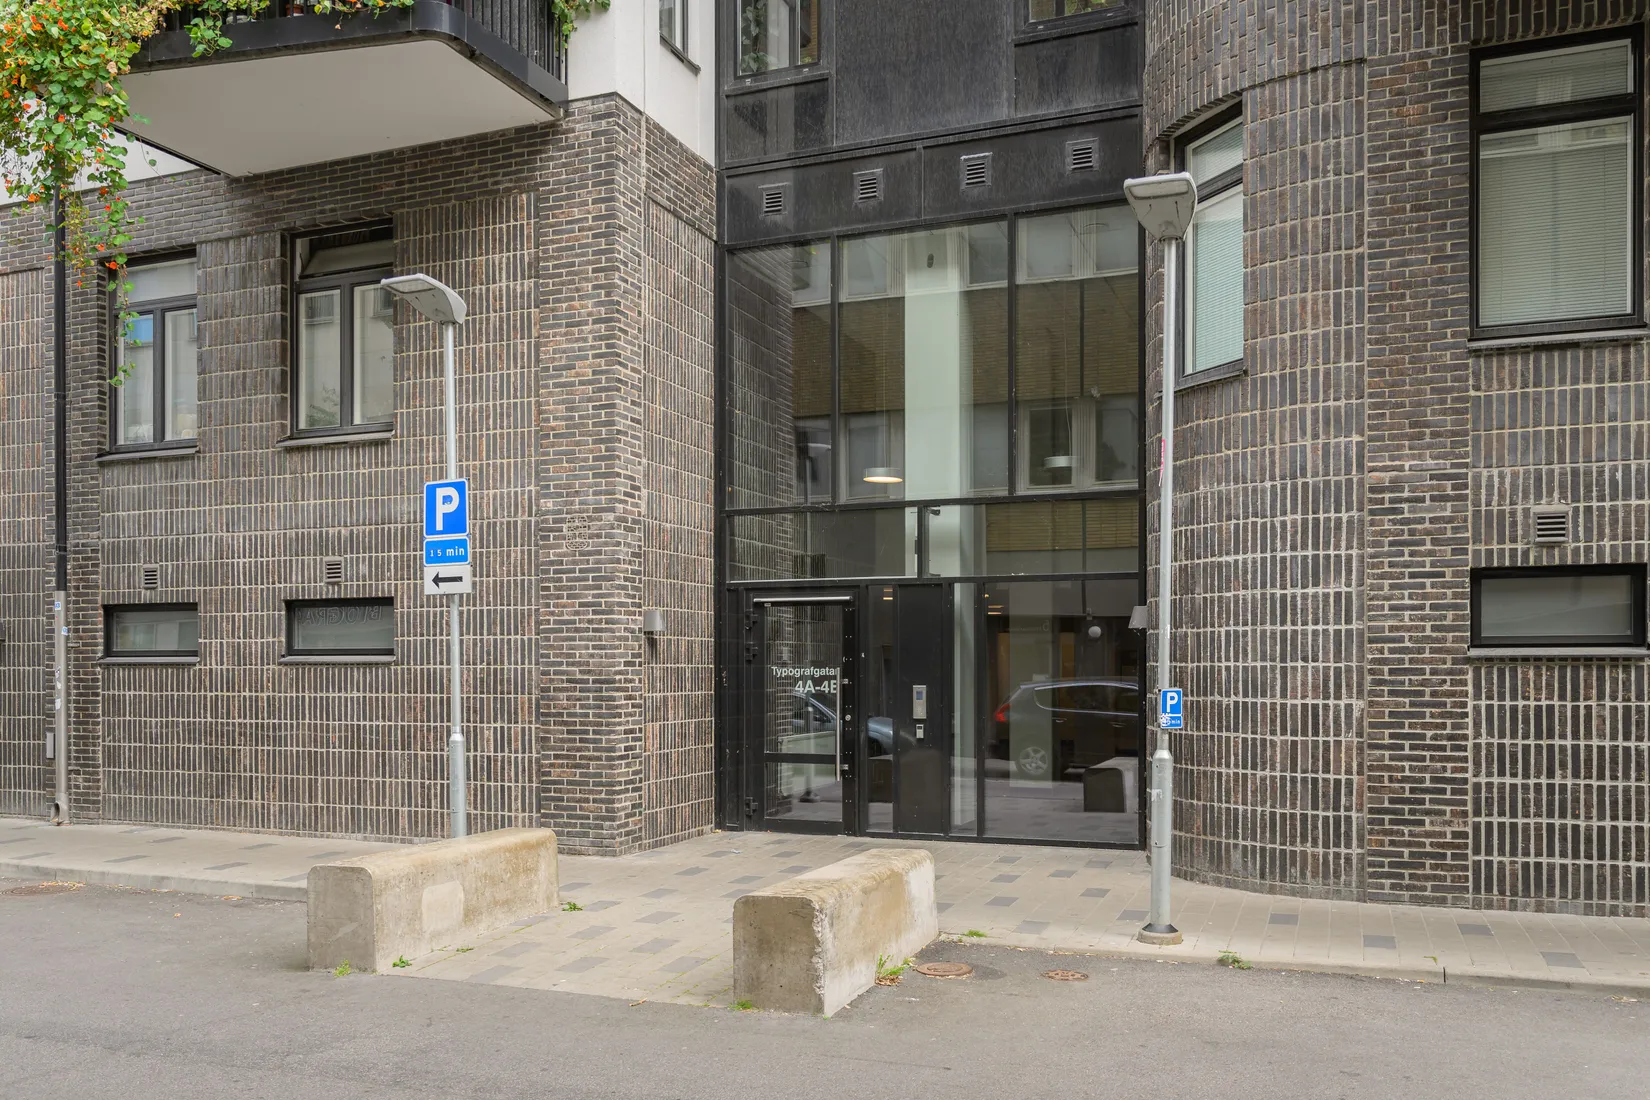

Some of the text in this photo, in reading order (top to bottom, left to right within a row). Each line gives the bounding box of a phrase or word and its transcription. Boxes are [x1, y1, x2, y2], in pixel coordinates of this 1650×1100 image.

[435, 486, 460, 531] P
[446, 546, 465, 557] min
[1166, 691, 1179, 713] P
